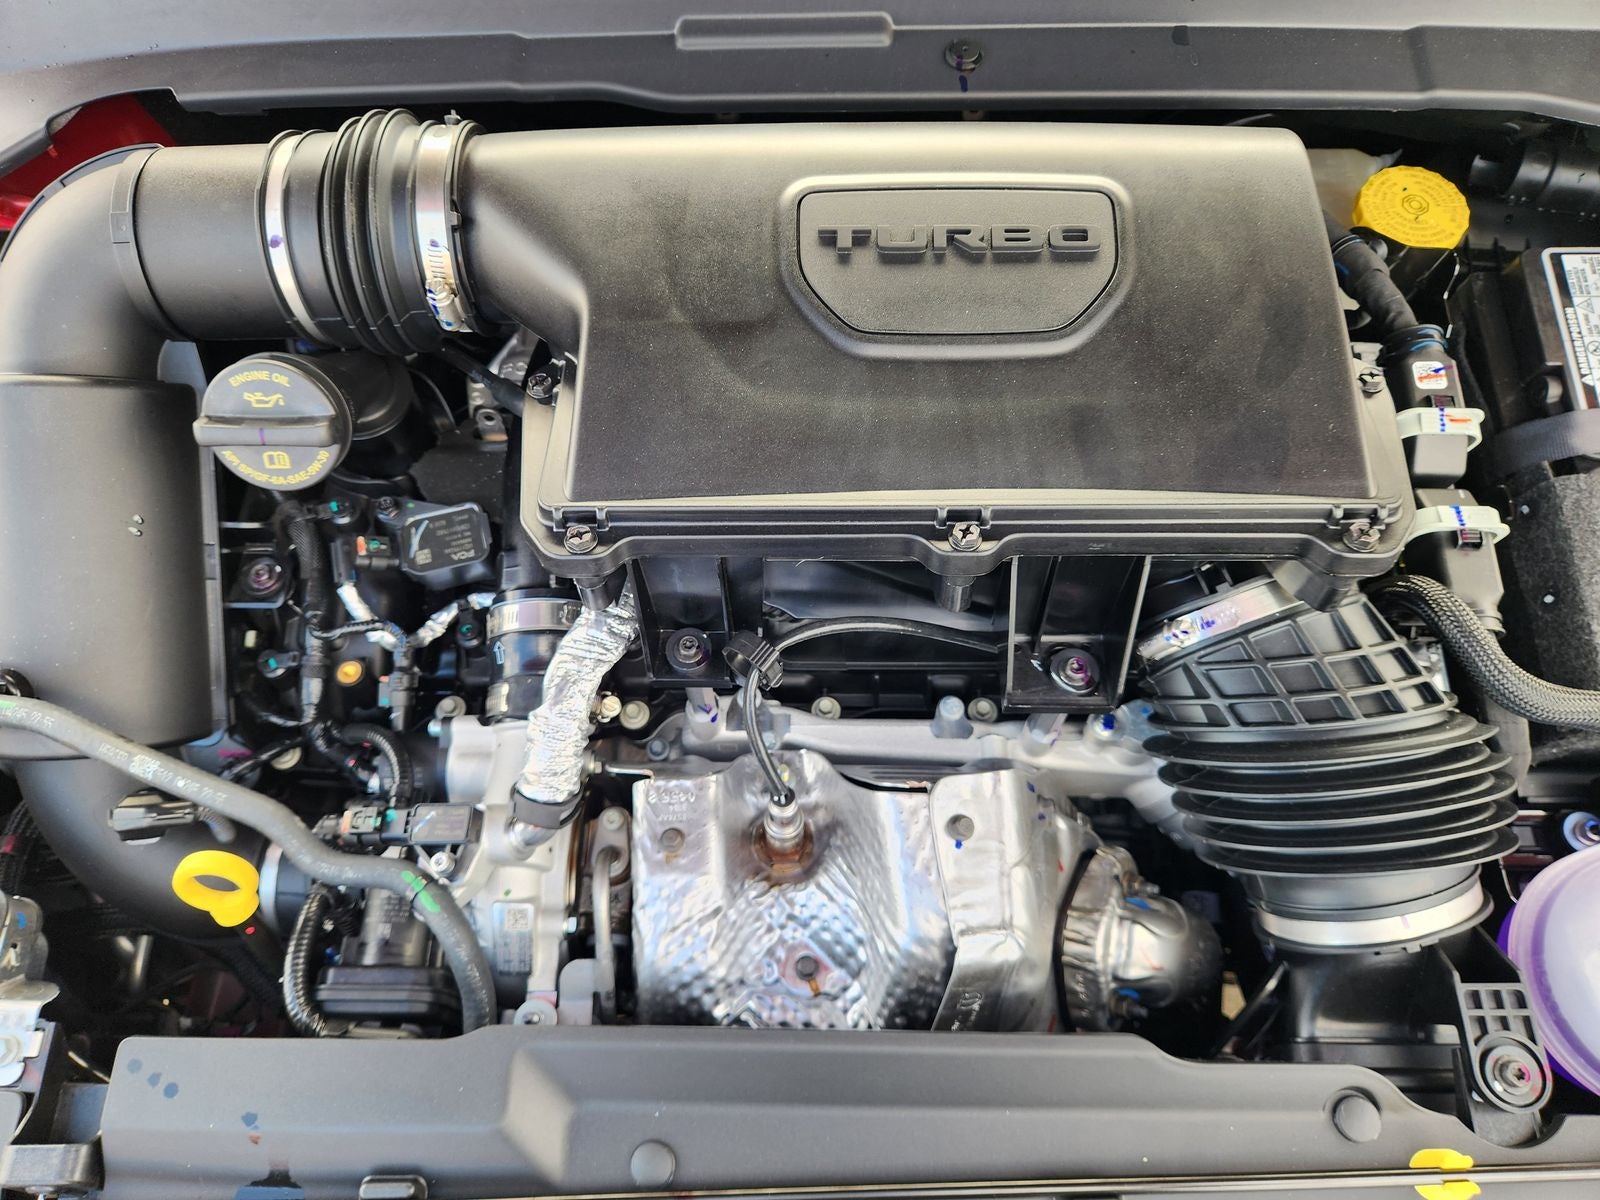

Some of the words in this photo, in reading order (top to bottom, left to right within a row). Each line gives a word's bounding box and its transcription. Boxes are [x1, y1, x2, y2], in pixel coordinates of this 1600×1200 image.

[818, 224, 1100, 254] TURBO
[1564, 307, 1591, 374] DANGER/POISON
[228, 370, 270, 387] ENGINE
[271, 373, 291, 387] OIL
[450, 549, 475, 561] FCA
